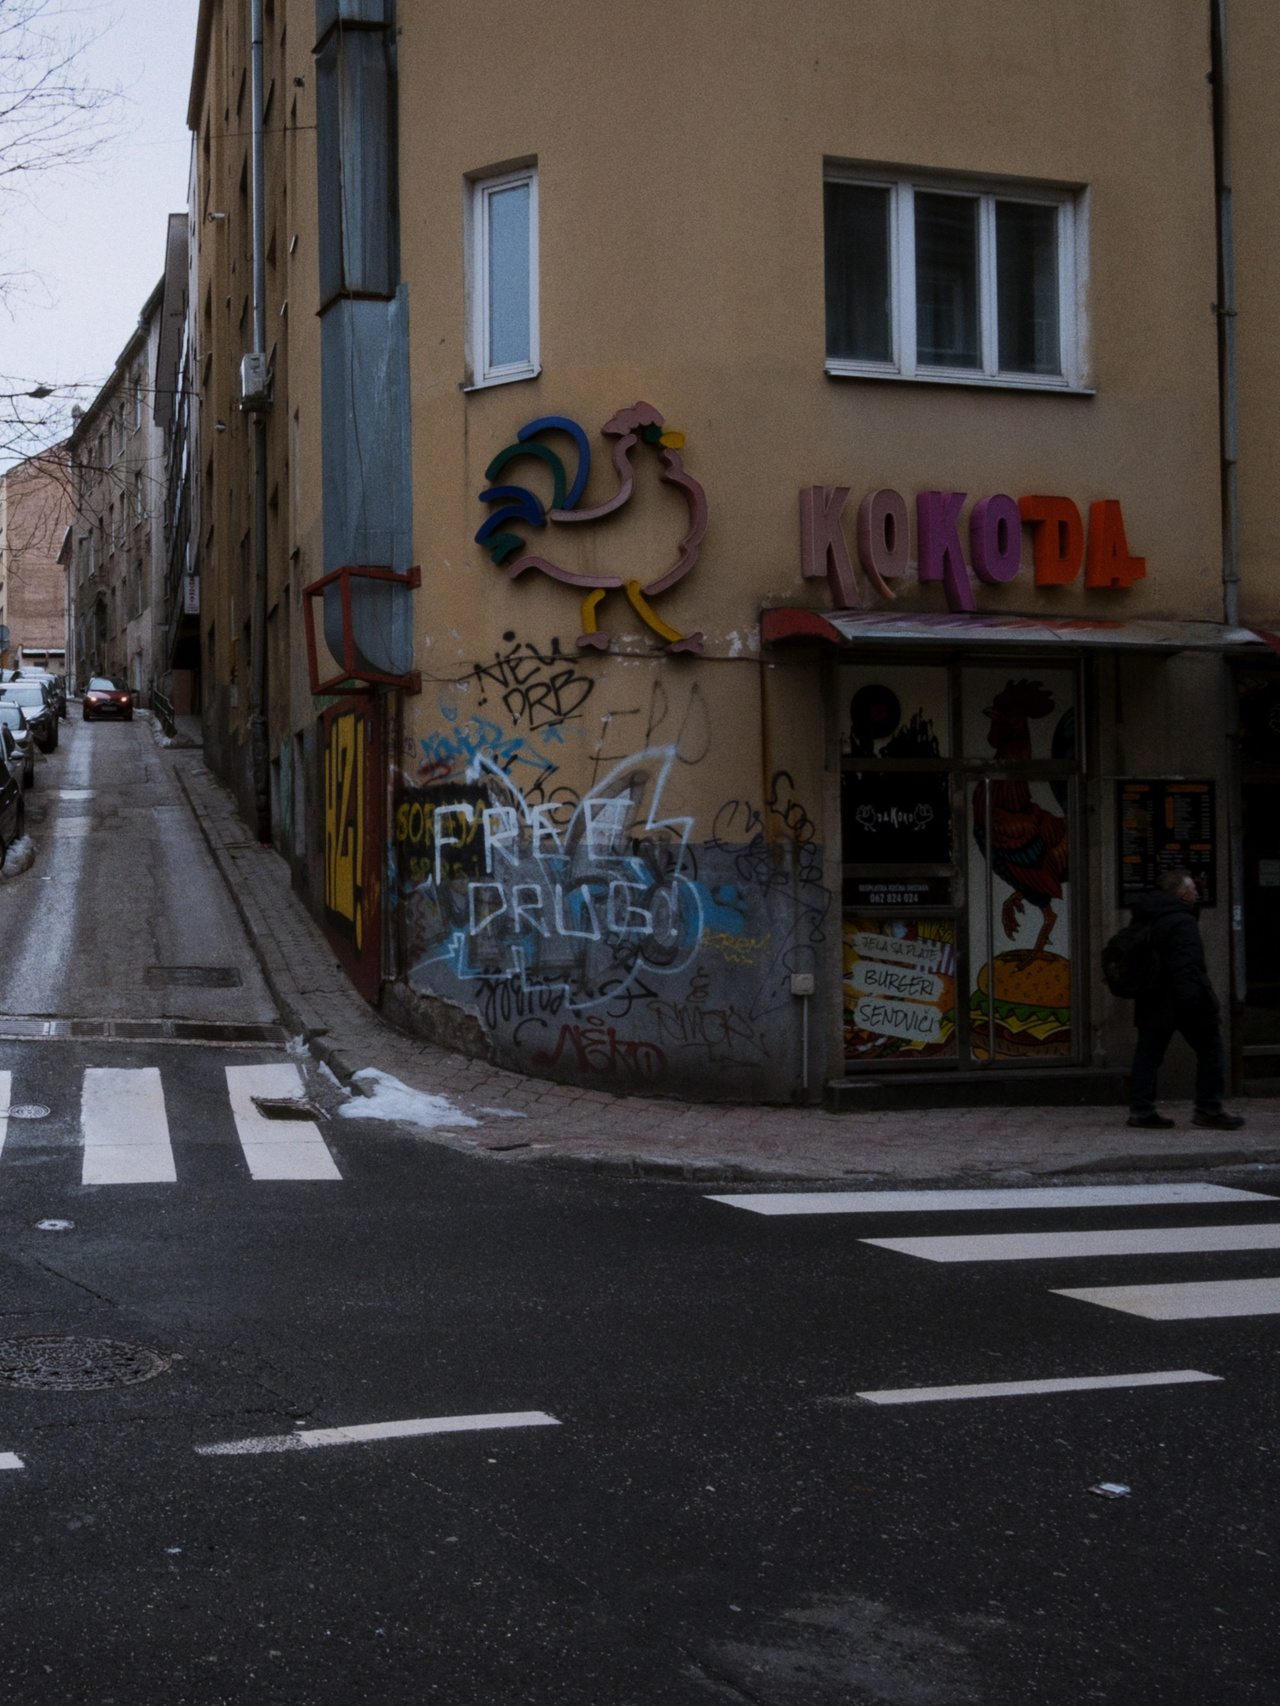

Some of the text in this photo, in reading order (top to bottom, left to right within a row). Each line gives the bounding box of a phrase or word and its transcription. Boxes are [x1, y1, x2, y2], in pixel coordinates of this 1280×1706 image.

[799, 485, 1146, 613] KOKODA
[433, 796, 648, 886] FREE
[869, 893, 885, 903] 062
[861, 936, 939, 961] JELA SA PLATE
[864, 969, 935, 996] BURGERI
[859, 1004, 935, 1034] SENDVIČI
